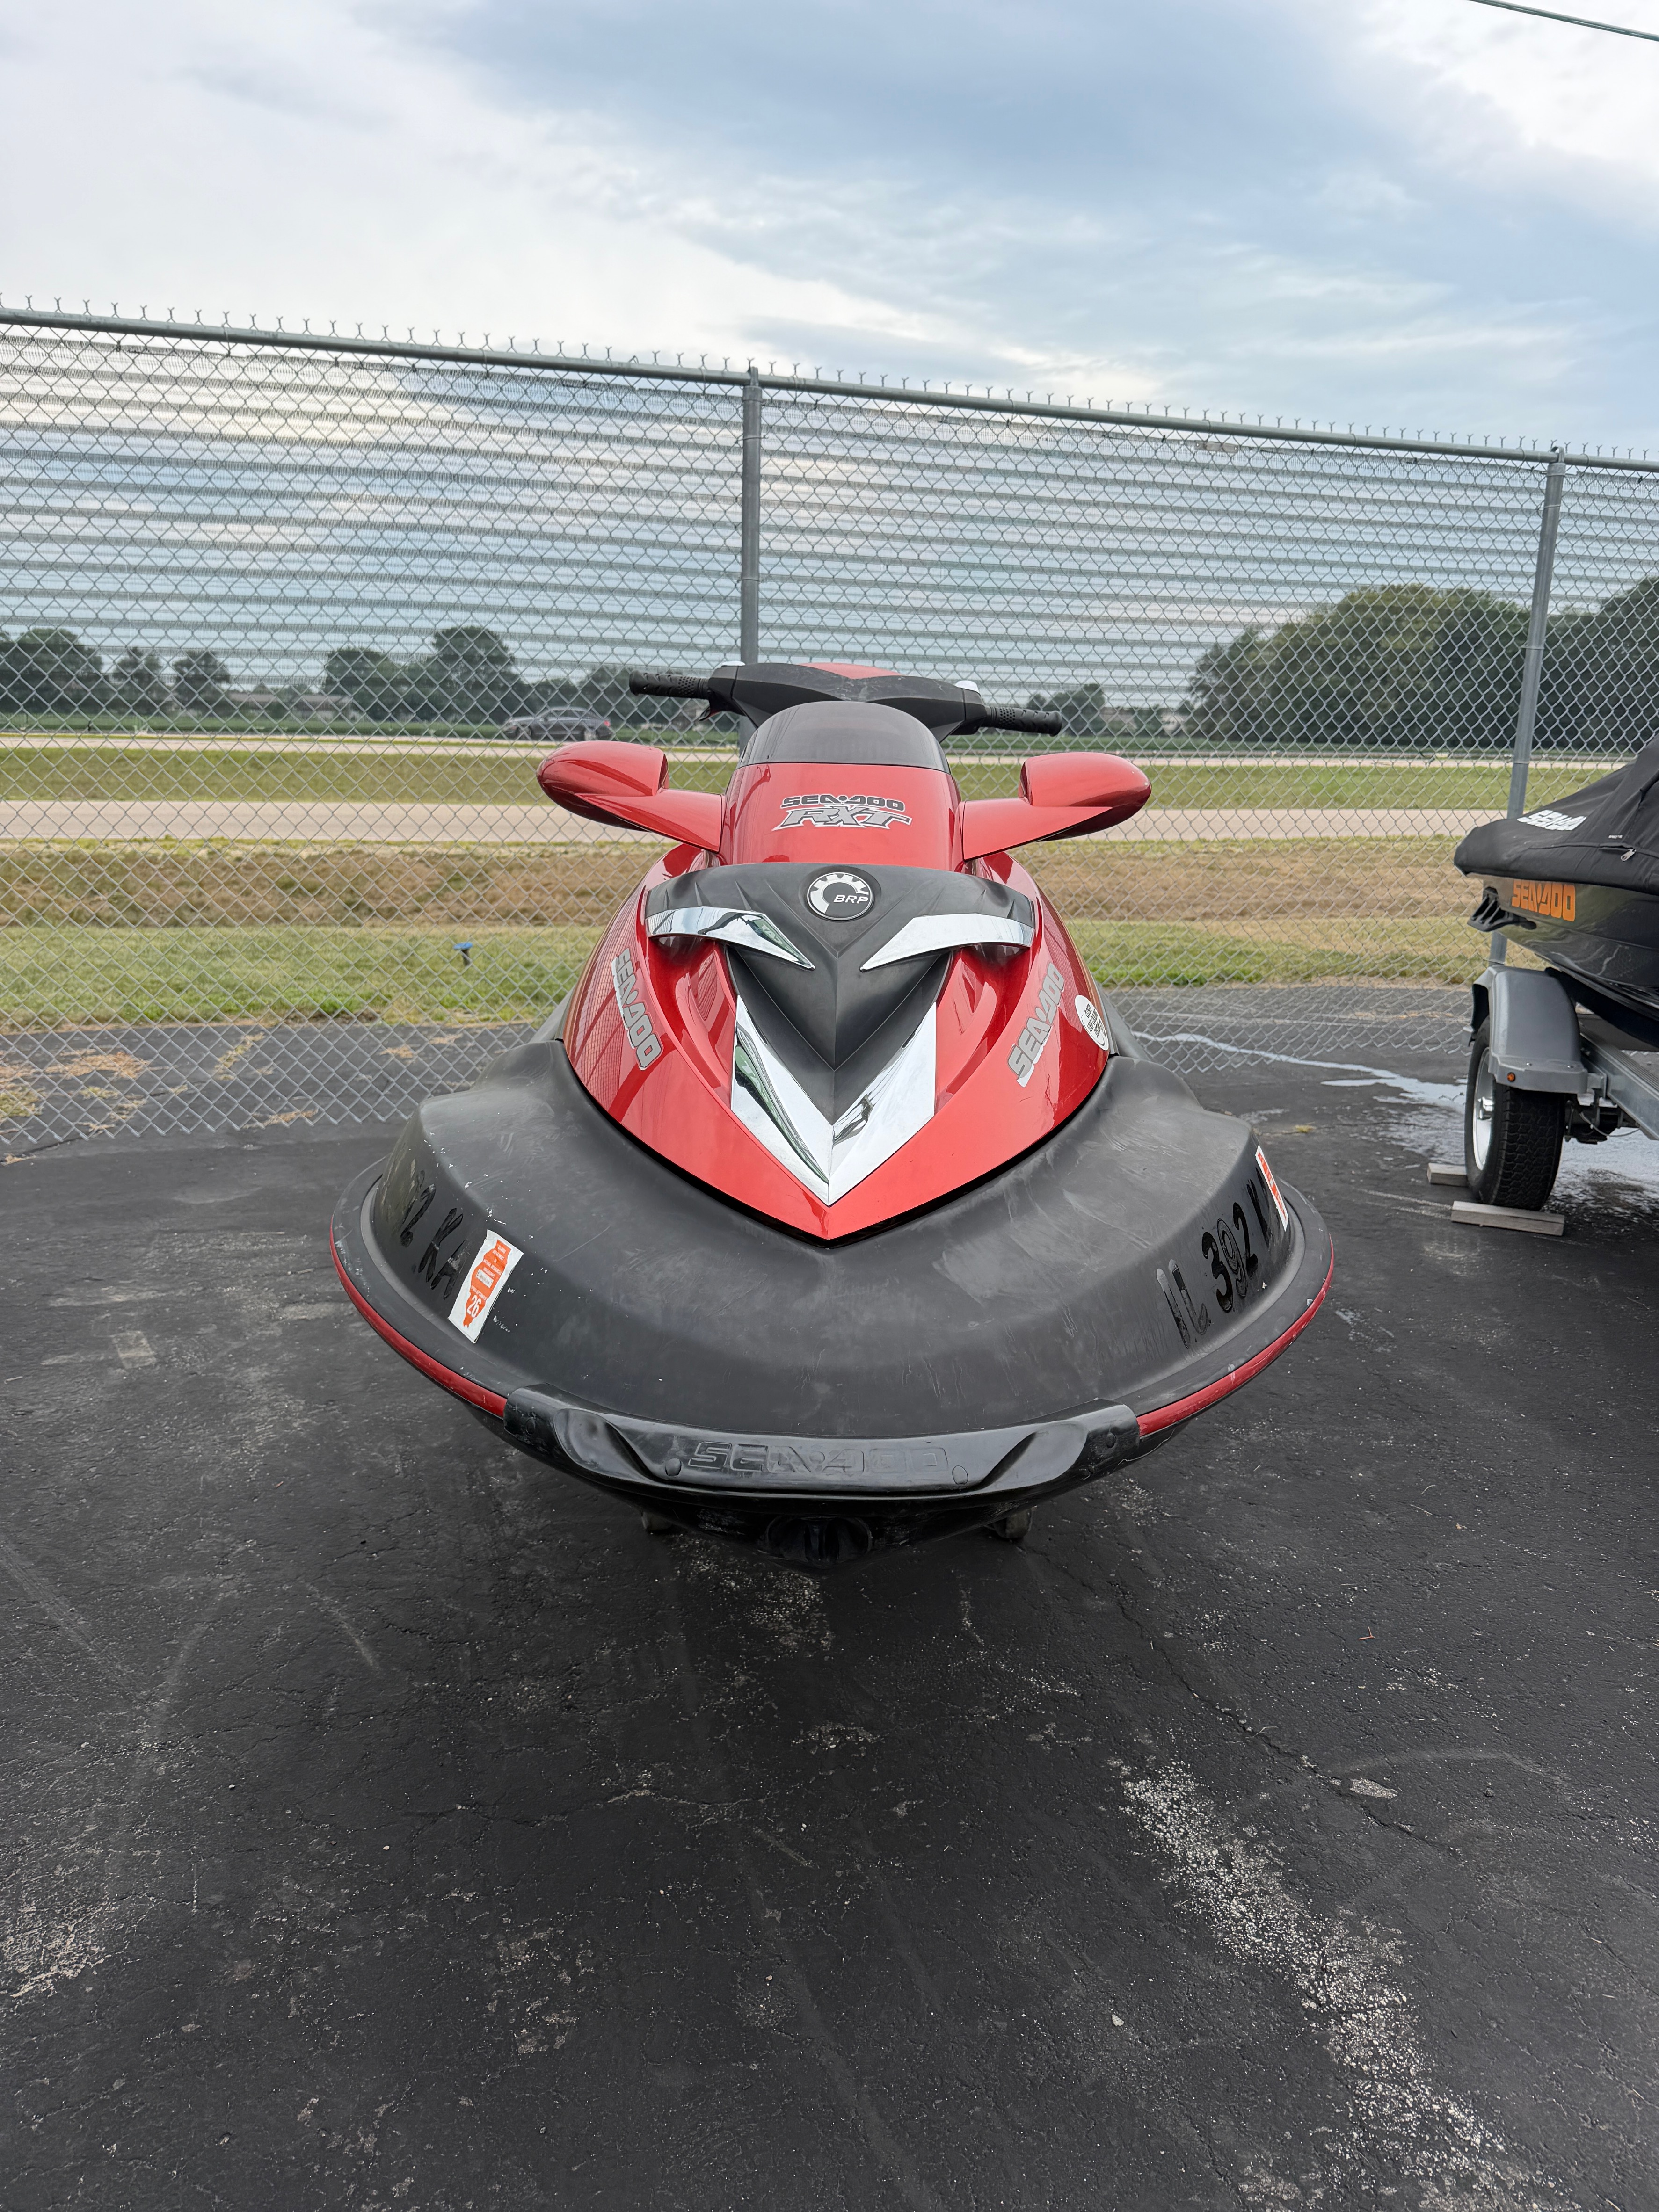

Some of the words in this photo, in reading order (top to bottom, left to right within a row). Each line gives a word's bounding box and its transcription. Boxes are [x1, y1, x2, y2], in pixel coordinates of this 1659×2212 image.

[771, 805, 912, 831] RXT
[834, 895, 869, 905] BRP
[1201, 1202, 1259, 1313] 392
[467, 1295, 481, 1318] 26
